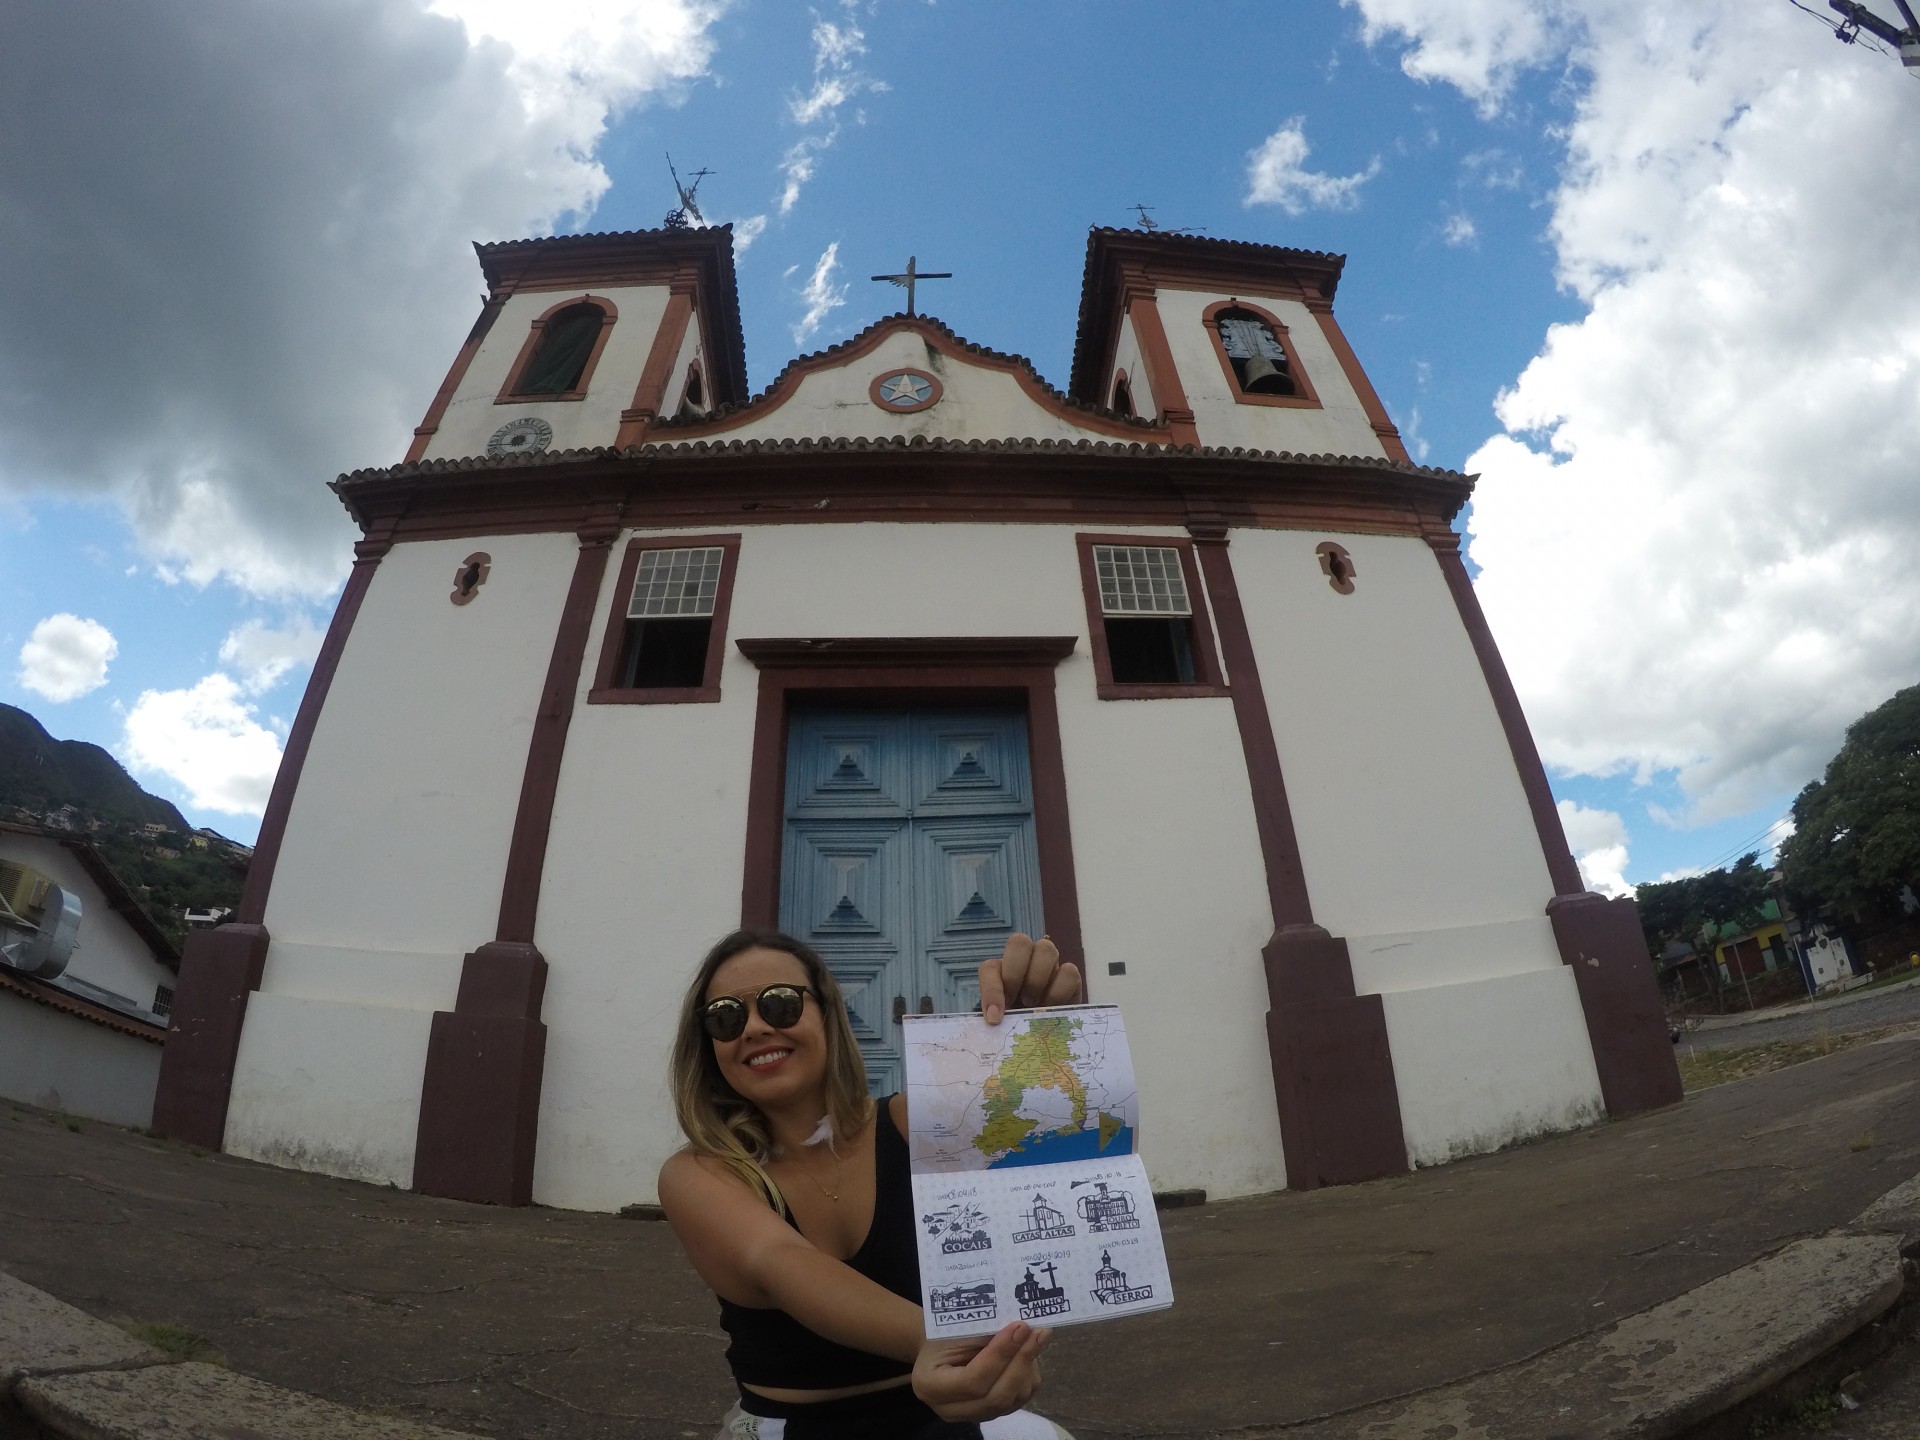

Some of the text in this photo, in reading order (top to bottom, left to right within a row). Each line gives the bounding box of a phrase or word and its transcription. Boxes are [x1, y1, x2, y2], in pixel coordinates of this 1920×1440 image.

[1108, 1215, 1131, 1223] OURO
[1112, 1221, 1138, 1229] PRETO
[1015, 1228, 1072, 1241] CATAS ALTAS
[944, 1240, 988, 1252] COCAIS
[1115, 1289, 1151, 1302] SERRO
[1032, 1296, 1063, 1309] MILHO
[940, 1310, 992, 1322] PARATY
[1023, 1305, 1065, 1317] VERDE
